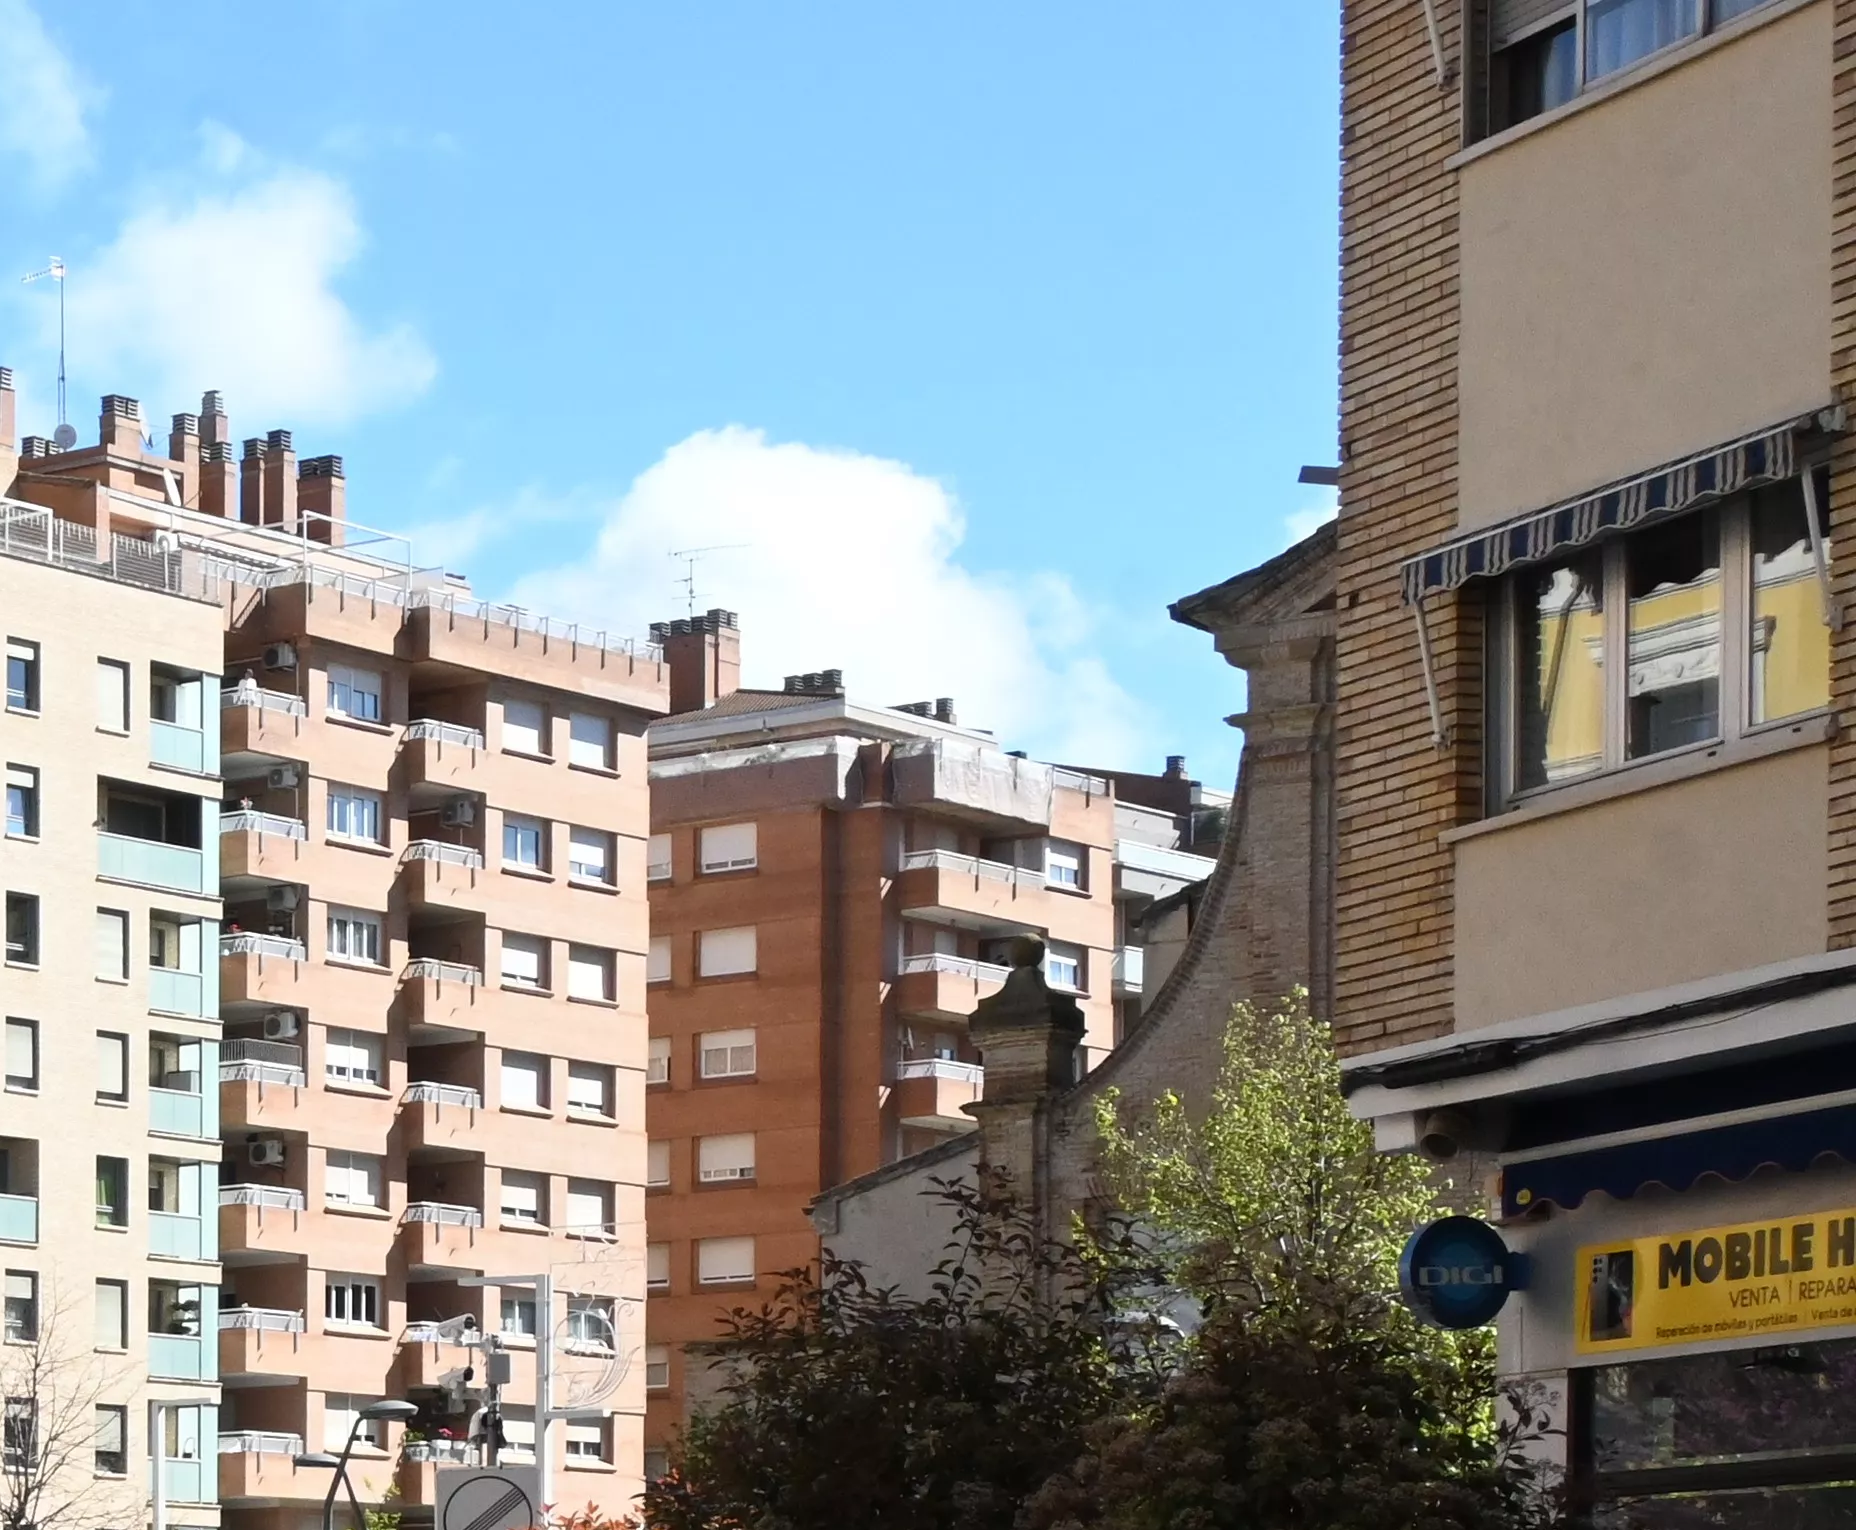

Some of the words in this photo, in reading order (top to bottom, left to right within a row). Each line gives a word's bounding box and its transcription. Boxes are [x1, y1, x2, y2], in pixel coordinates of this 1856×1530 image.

[1658, 1222, 1815, 1290] MOBILE
[1419, 1265, 1504, 1287] DIGI
[1728, 1285, 1781, 1309] VENTA
